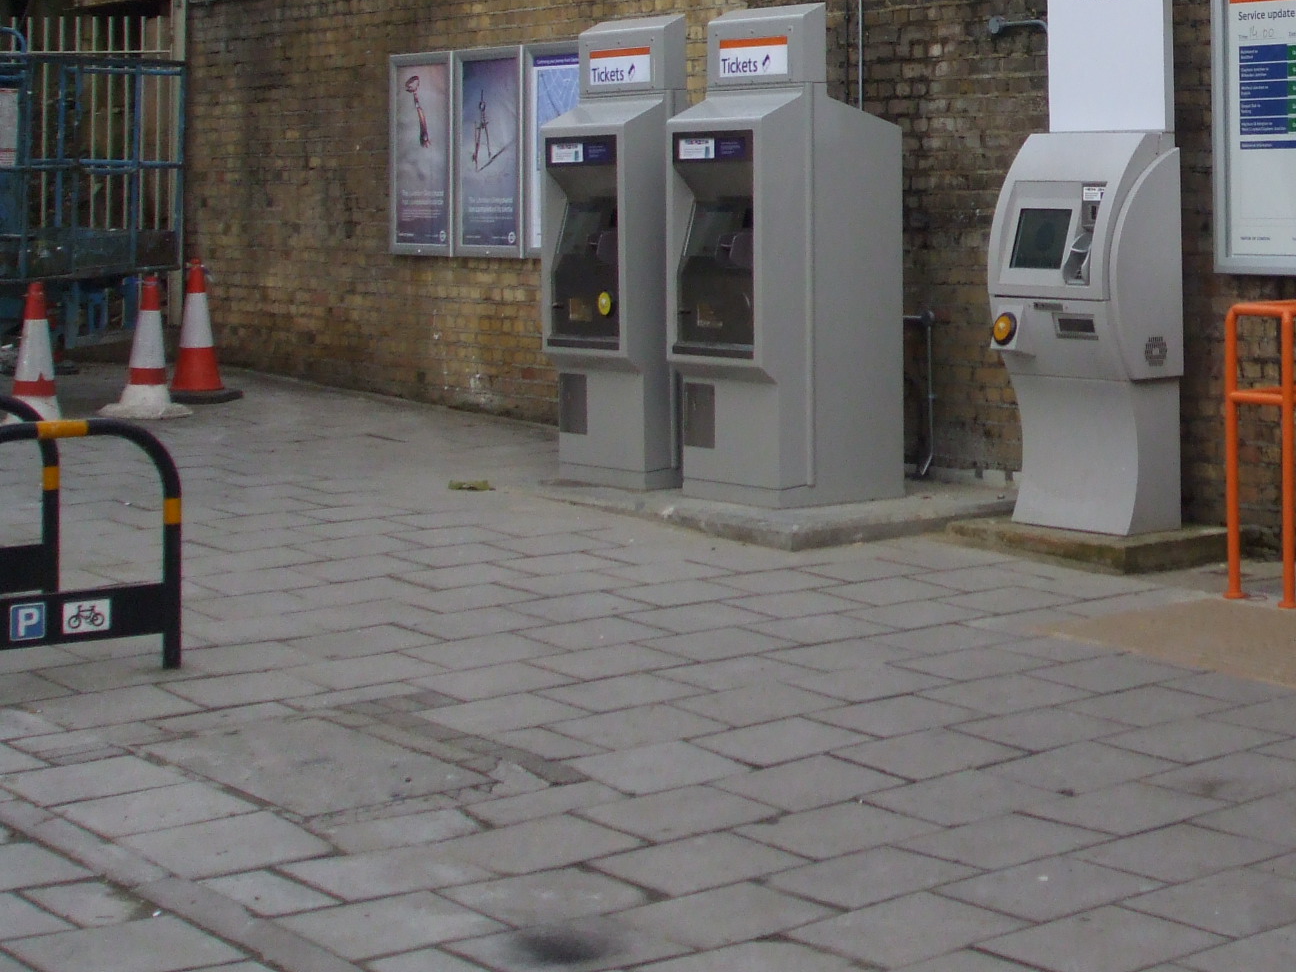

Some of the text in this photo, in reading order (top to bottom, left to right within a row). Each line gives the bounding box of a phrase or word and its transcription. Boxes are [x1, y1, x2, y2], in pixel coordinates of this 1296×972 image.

[1238, 9, 1295, 20] Service update
[722, 57, 758, 74] Tickets
[592, 66, 624, 83] Tickets
[18, 608, 39, 637] P
